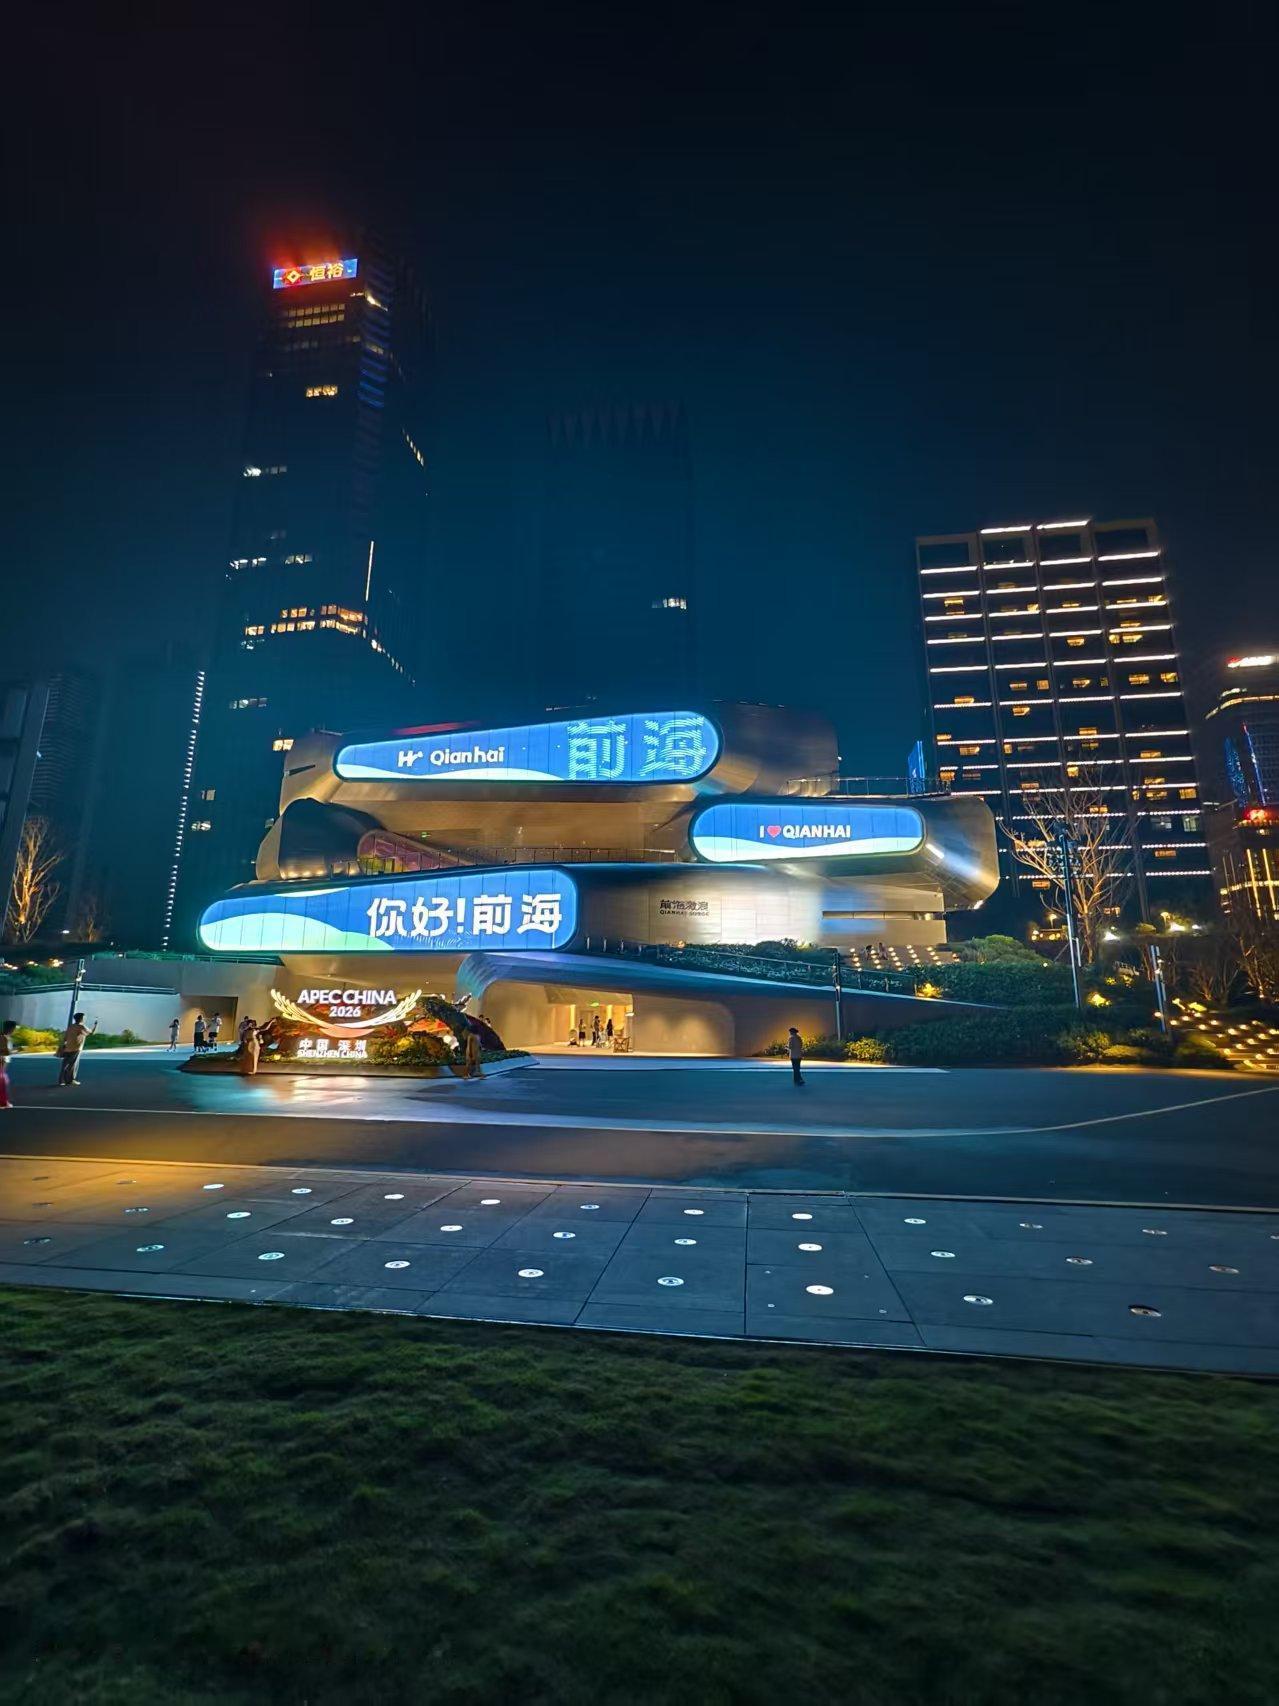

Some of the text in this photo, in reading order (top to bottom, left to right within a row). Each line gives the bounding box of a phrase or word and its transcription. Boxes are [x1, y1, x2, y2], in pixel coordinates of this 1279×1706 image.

[309, 263, 344, 281] 恒裕
[430, 746, 505, 766] Qianhai
[759, 824, 851, 839] I QIANHAI
[297, 989, 397, 1005] APEC CHINA
[329, 1005, 362, 1018] 2026
[340, 1049, 368, 1059] CHINA
